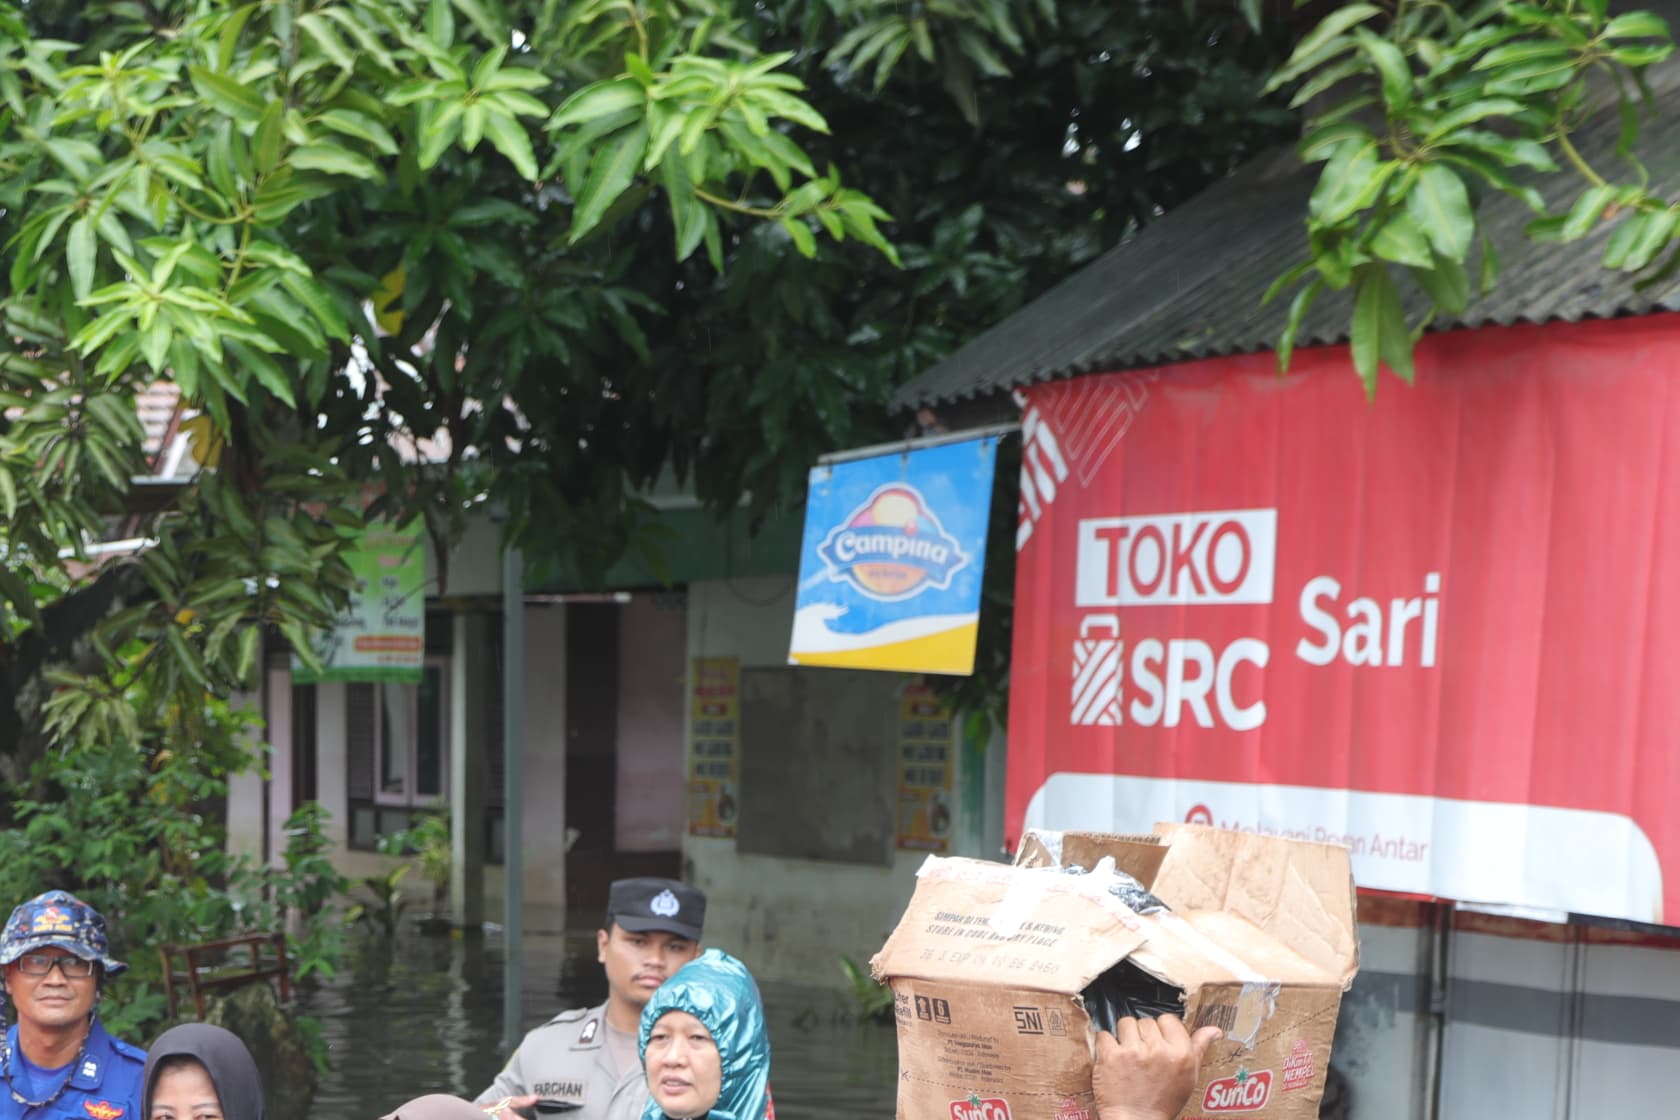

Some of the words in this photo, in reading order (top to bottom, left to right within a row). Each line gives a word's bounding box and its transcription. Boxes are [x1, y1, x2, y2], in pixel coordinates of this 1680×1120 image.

[834, 531, 950, 565] Campina
[1094, 519, 1252, 599] TOKO
[1296, 572, 1441, 668] Sari
[1129, 637, 1270, 732] SRC
[1369, 832, 1429, 863] Antar
[1014, 1010, 1044, 1031] SNI
[1207, 1076, 1265, 1108] SunCo
